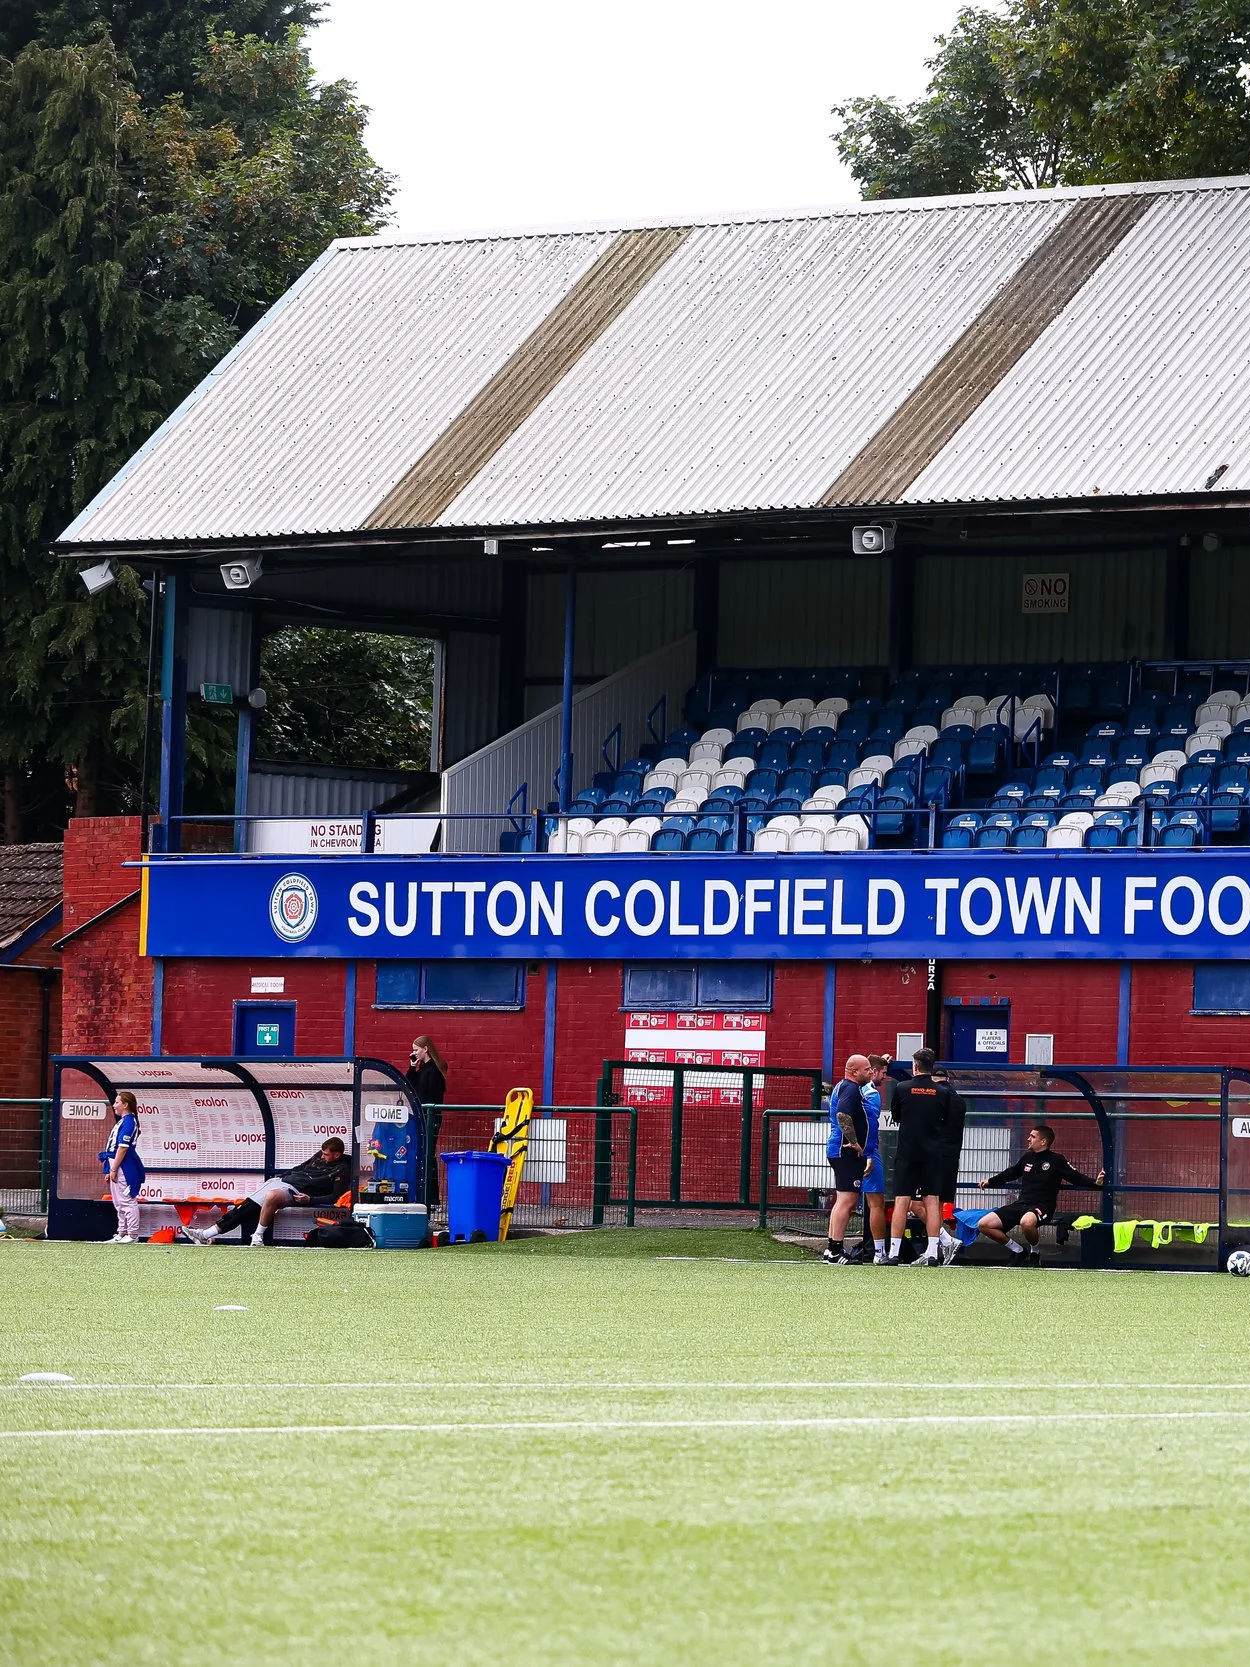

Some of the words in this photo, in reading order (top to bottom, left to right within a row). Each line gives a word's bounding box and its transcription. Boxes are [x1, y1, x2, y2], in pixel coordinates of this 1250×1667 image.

[1040, 578, 1066, 596] NO
[1024, 598, 1066, 608] SMOKING
[311, 825, 326, 836] NO
[328, 824, 382, 836] STANDG
[310, 839, 318, 848] IN
[320, 838, 358, 848] CHEVRON
[348, 881, 562, 936] SUTTON
[586, 879, 904, 936] COLDFIELD
[925, 877, 1101, 935] TOWN
[270, 1090, 304, 1099] exolon
[194, 1097, 228, 1107] exolon
[137, 1103, 159, 1114] olon
[372, 1108, 402, 1119] HOME
[314, 1125, 347, 1136] exolon
[164, 1141, 197, 1153] exolon
[201, 1179, 234, 1190] exolon
[140, 1186, 162, 1197] olon
